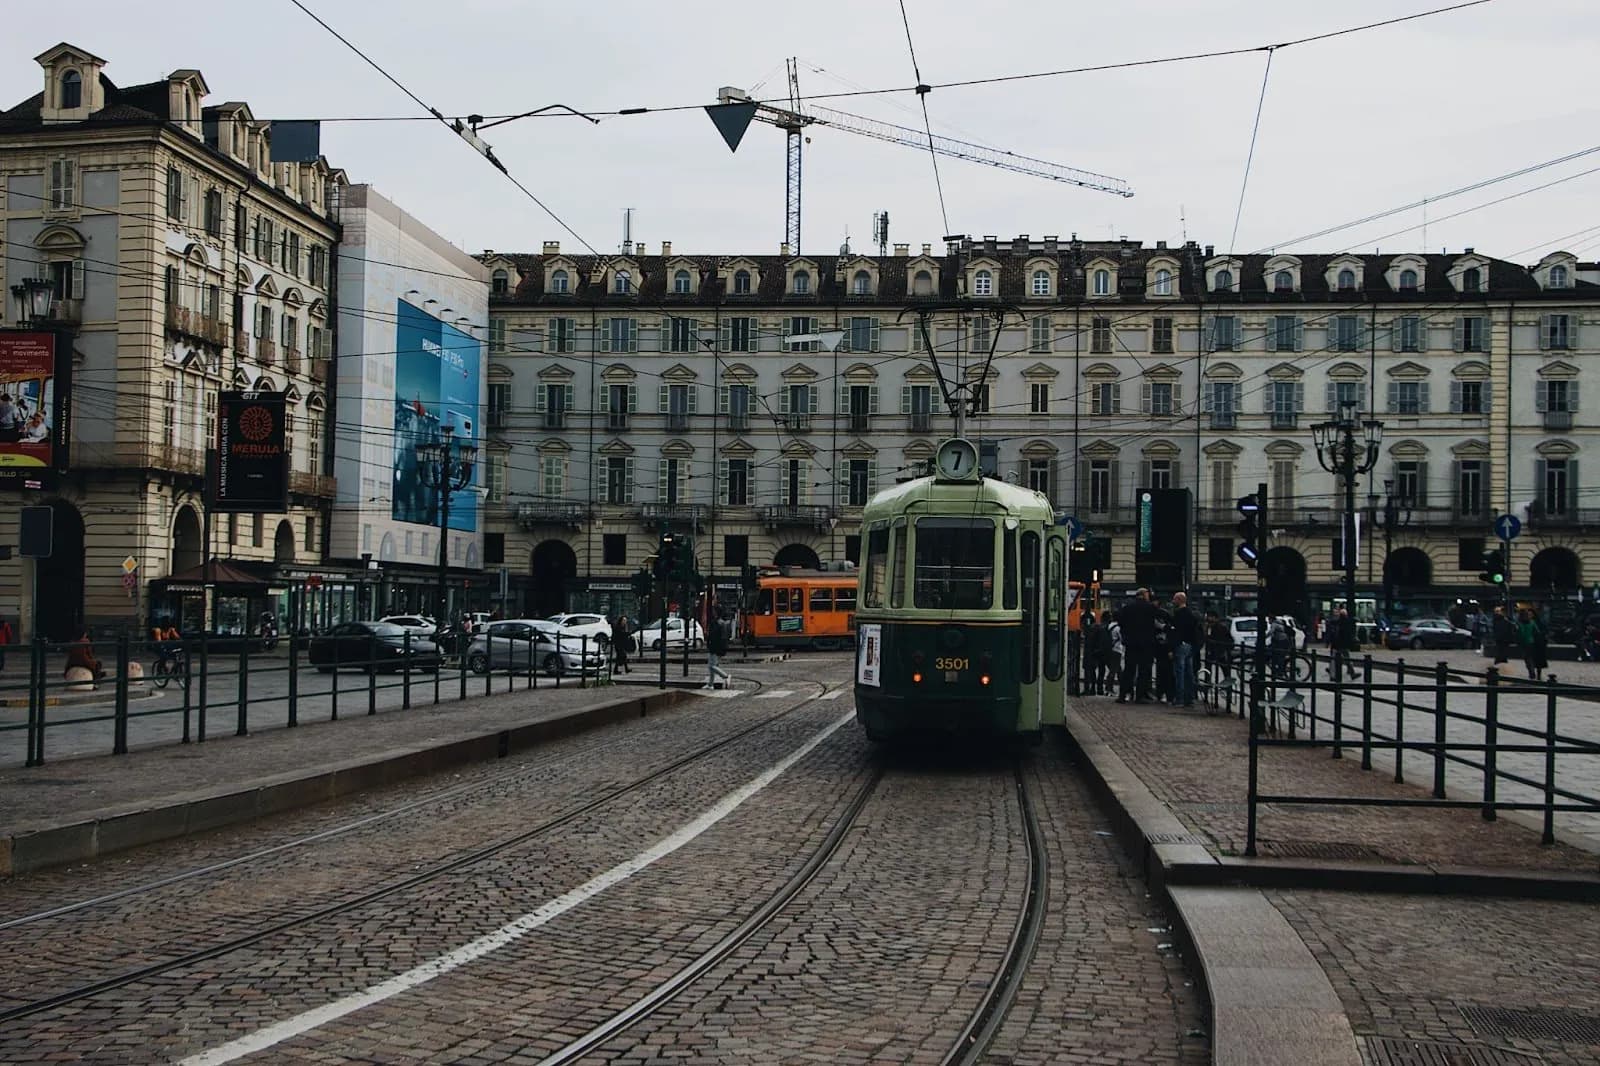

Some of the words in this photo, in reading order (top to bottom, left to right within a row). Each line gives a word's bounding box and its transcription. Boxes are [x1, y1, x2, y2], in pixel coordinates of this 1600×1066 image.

[241, 392, 260, 400] GTT
[232, 443, 280, 454] MERULA
[951, 450, 962, 470] 7
[220, 487, 226, 497] LA
[935, 657, 969, 670] 3501
